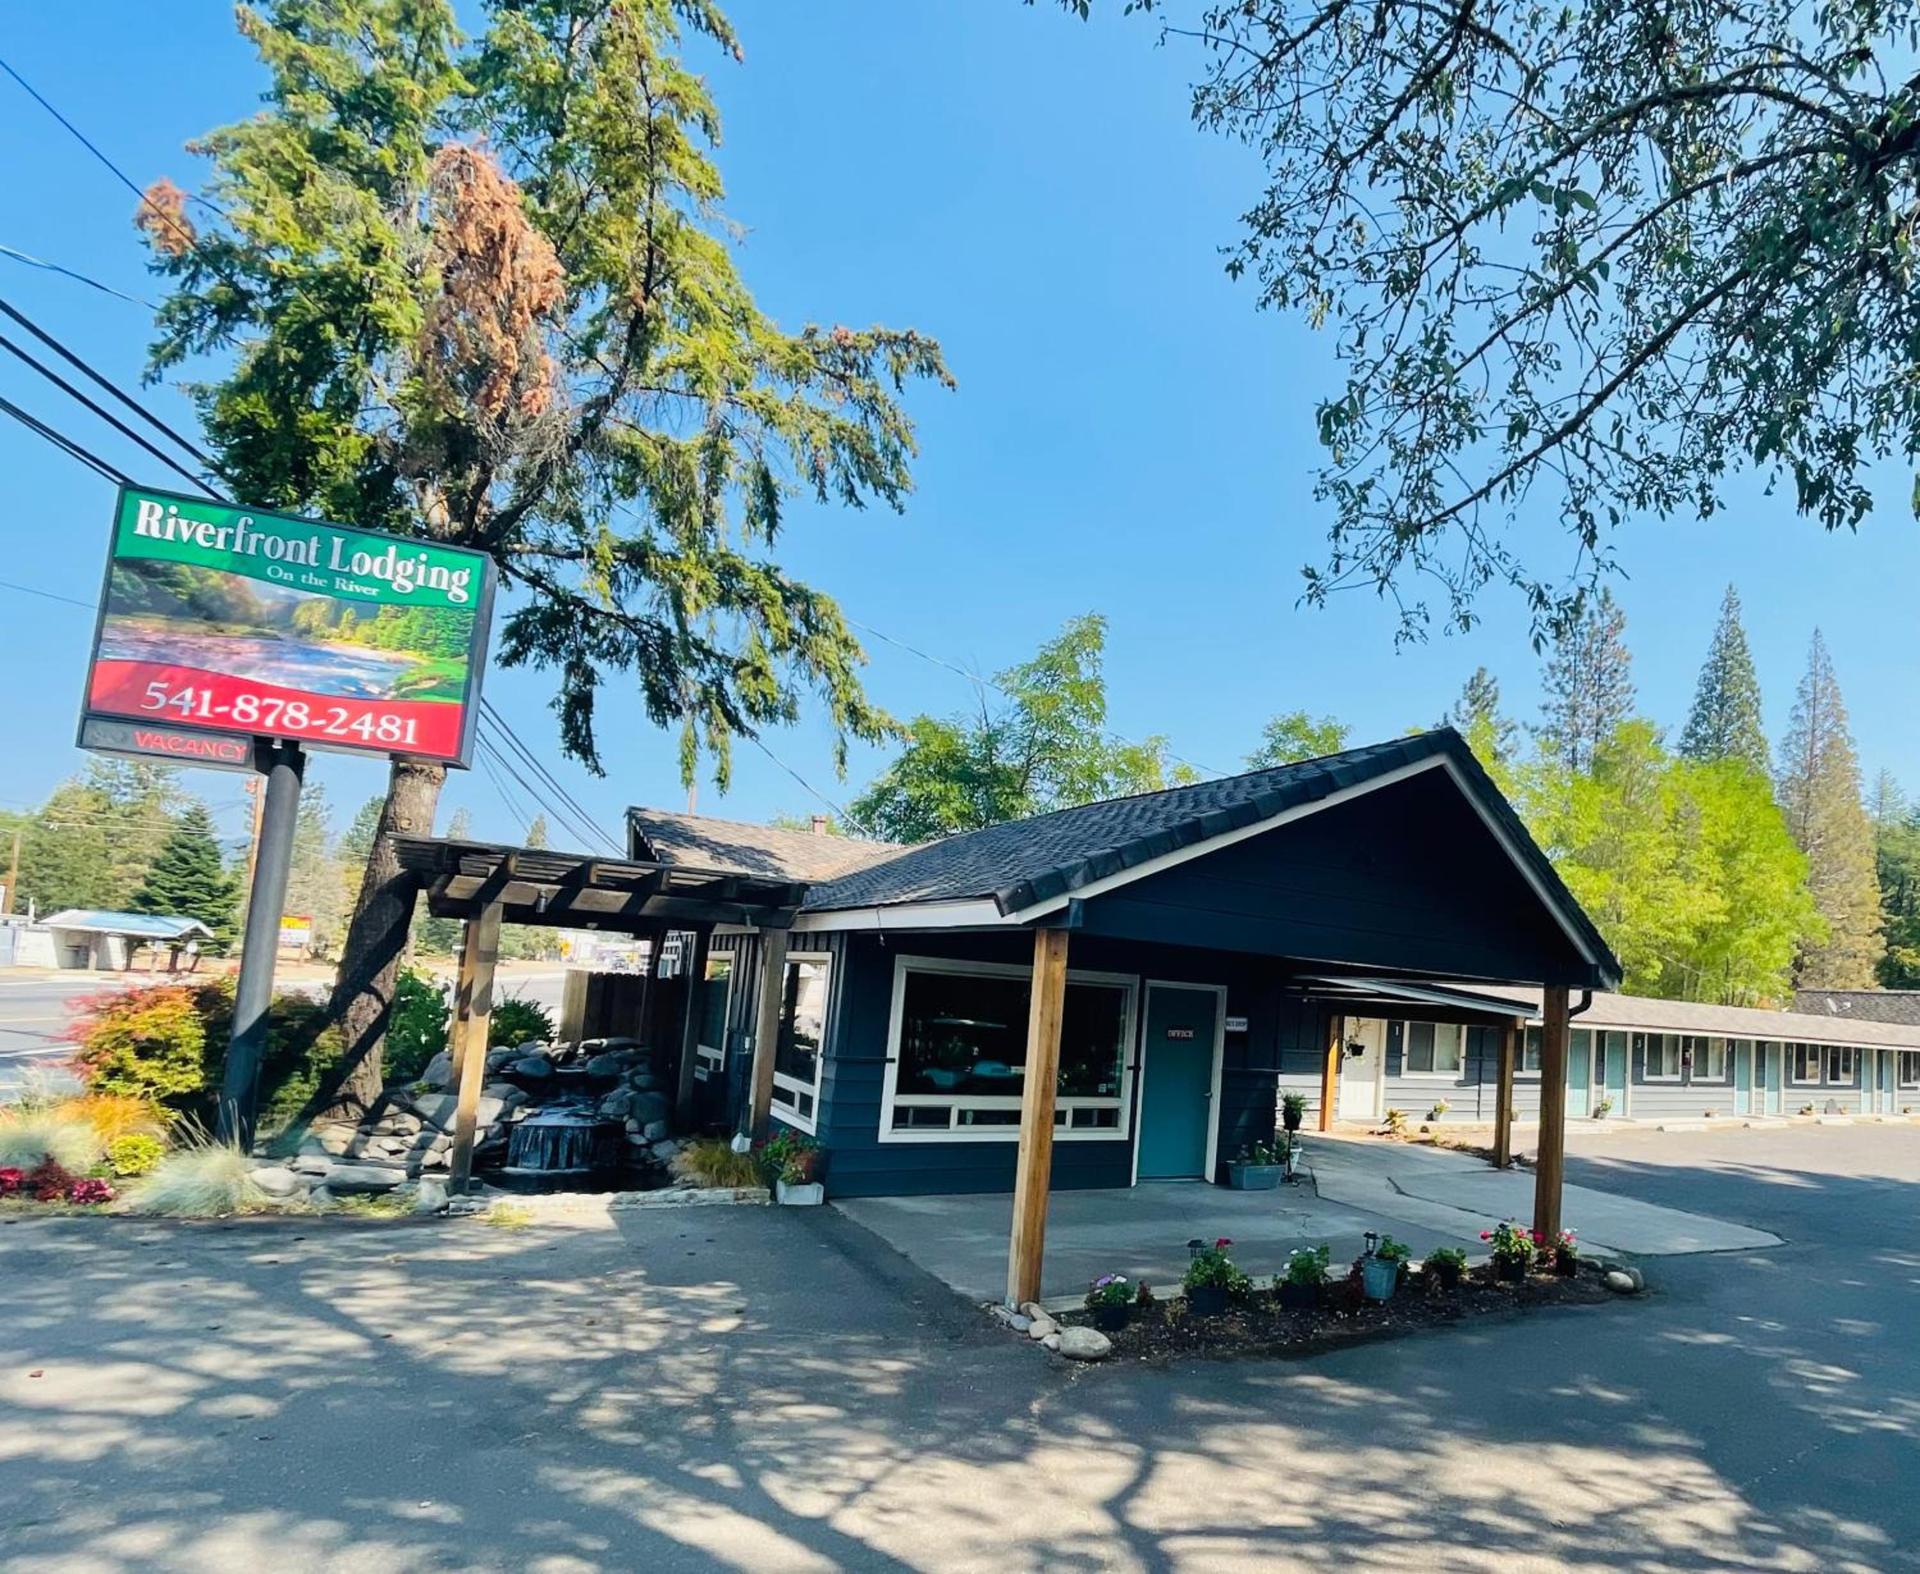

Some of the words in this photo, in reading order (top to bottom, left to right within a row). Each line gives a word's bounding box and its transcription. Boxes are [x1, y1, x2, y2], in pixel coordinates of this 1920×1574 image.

[133, 499, 322, 567] Riverfront
[328, 535, 471, 604] Lodging
[266, 565, 295, 582] On
[301, 572, 328, 588] the
[335, 576, 380, 597] River
[140, 682, 418, 745] 541-878-2481
[133, 730, 248, 761] VACANCY
